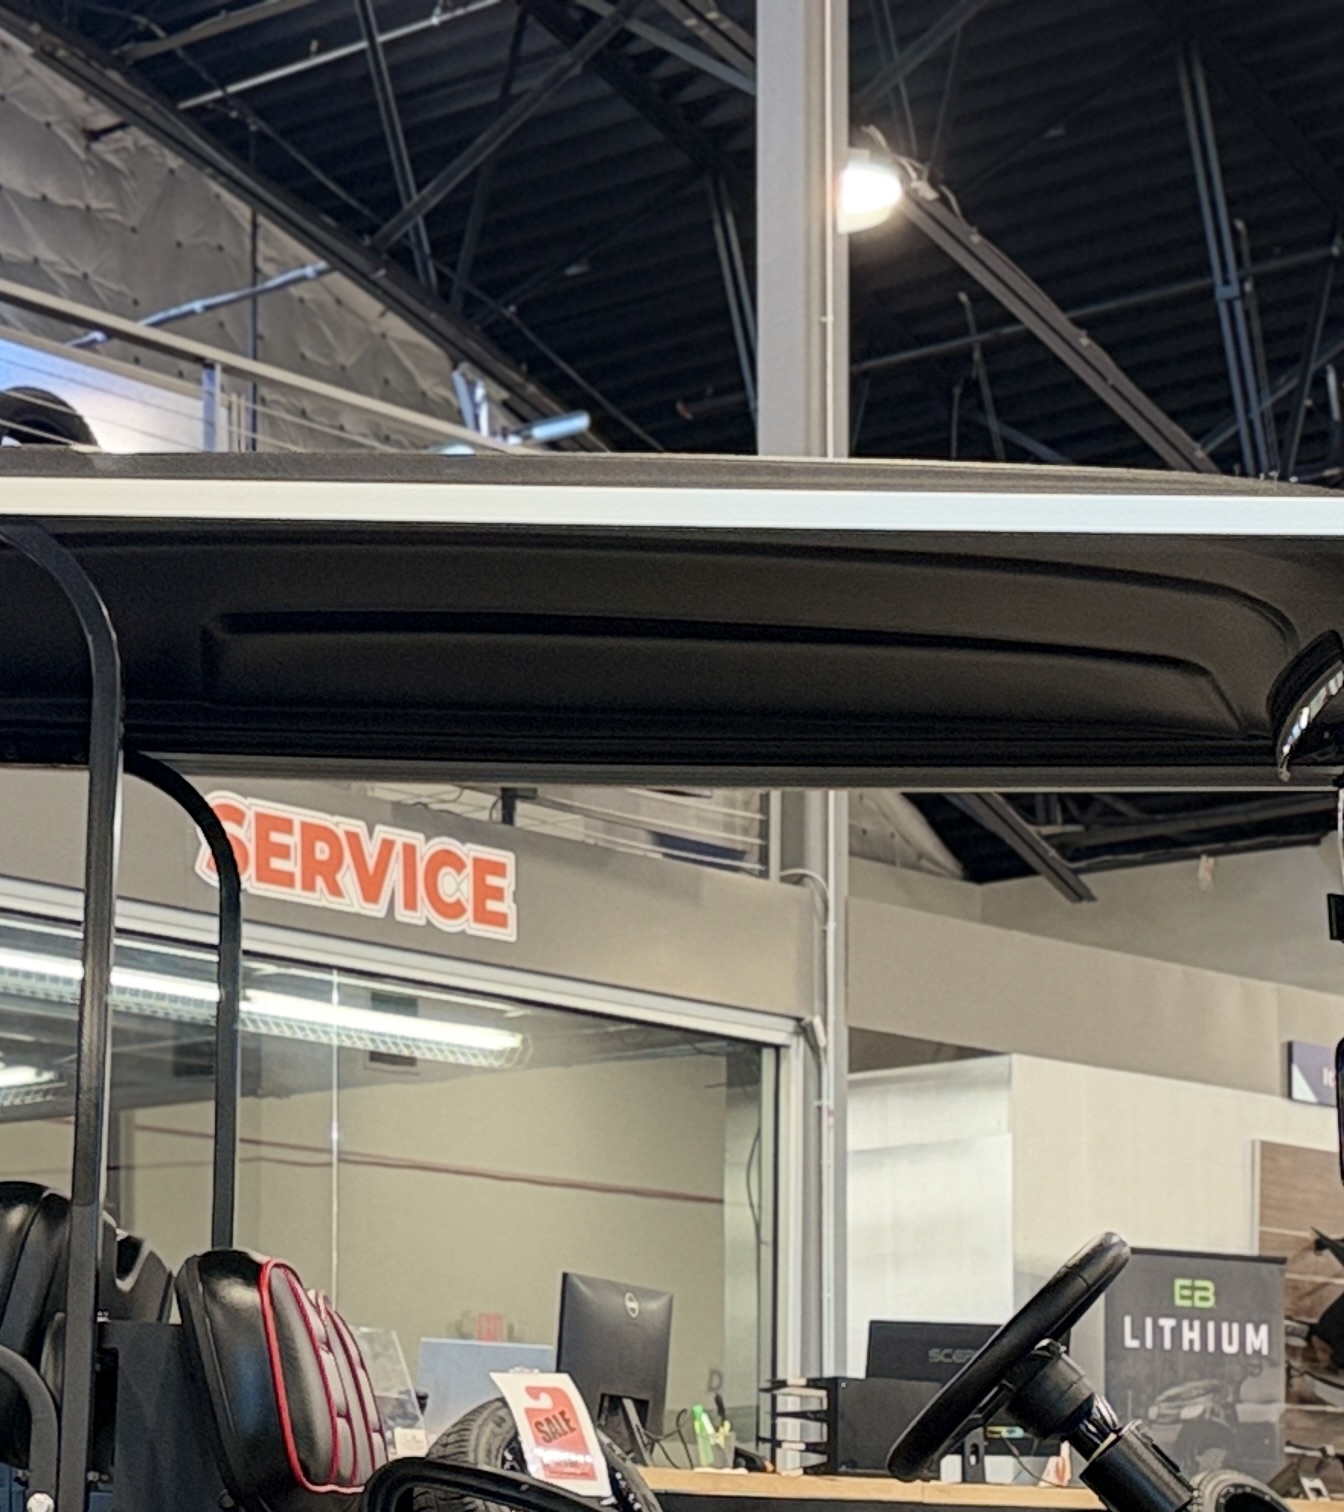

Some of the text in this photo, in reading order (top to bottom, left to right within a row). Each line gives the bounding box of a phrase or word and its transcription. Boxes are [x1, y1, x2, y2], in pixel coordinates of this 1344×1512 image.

[199, 794, 515, 940] SERVICE
[1123, 1314, 1269, 1356] LITHIUM
[534, 1409, 577, 1444] SALE
